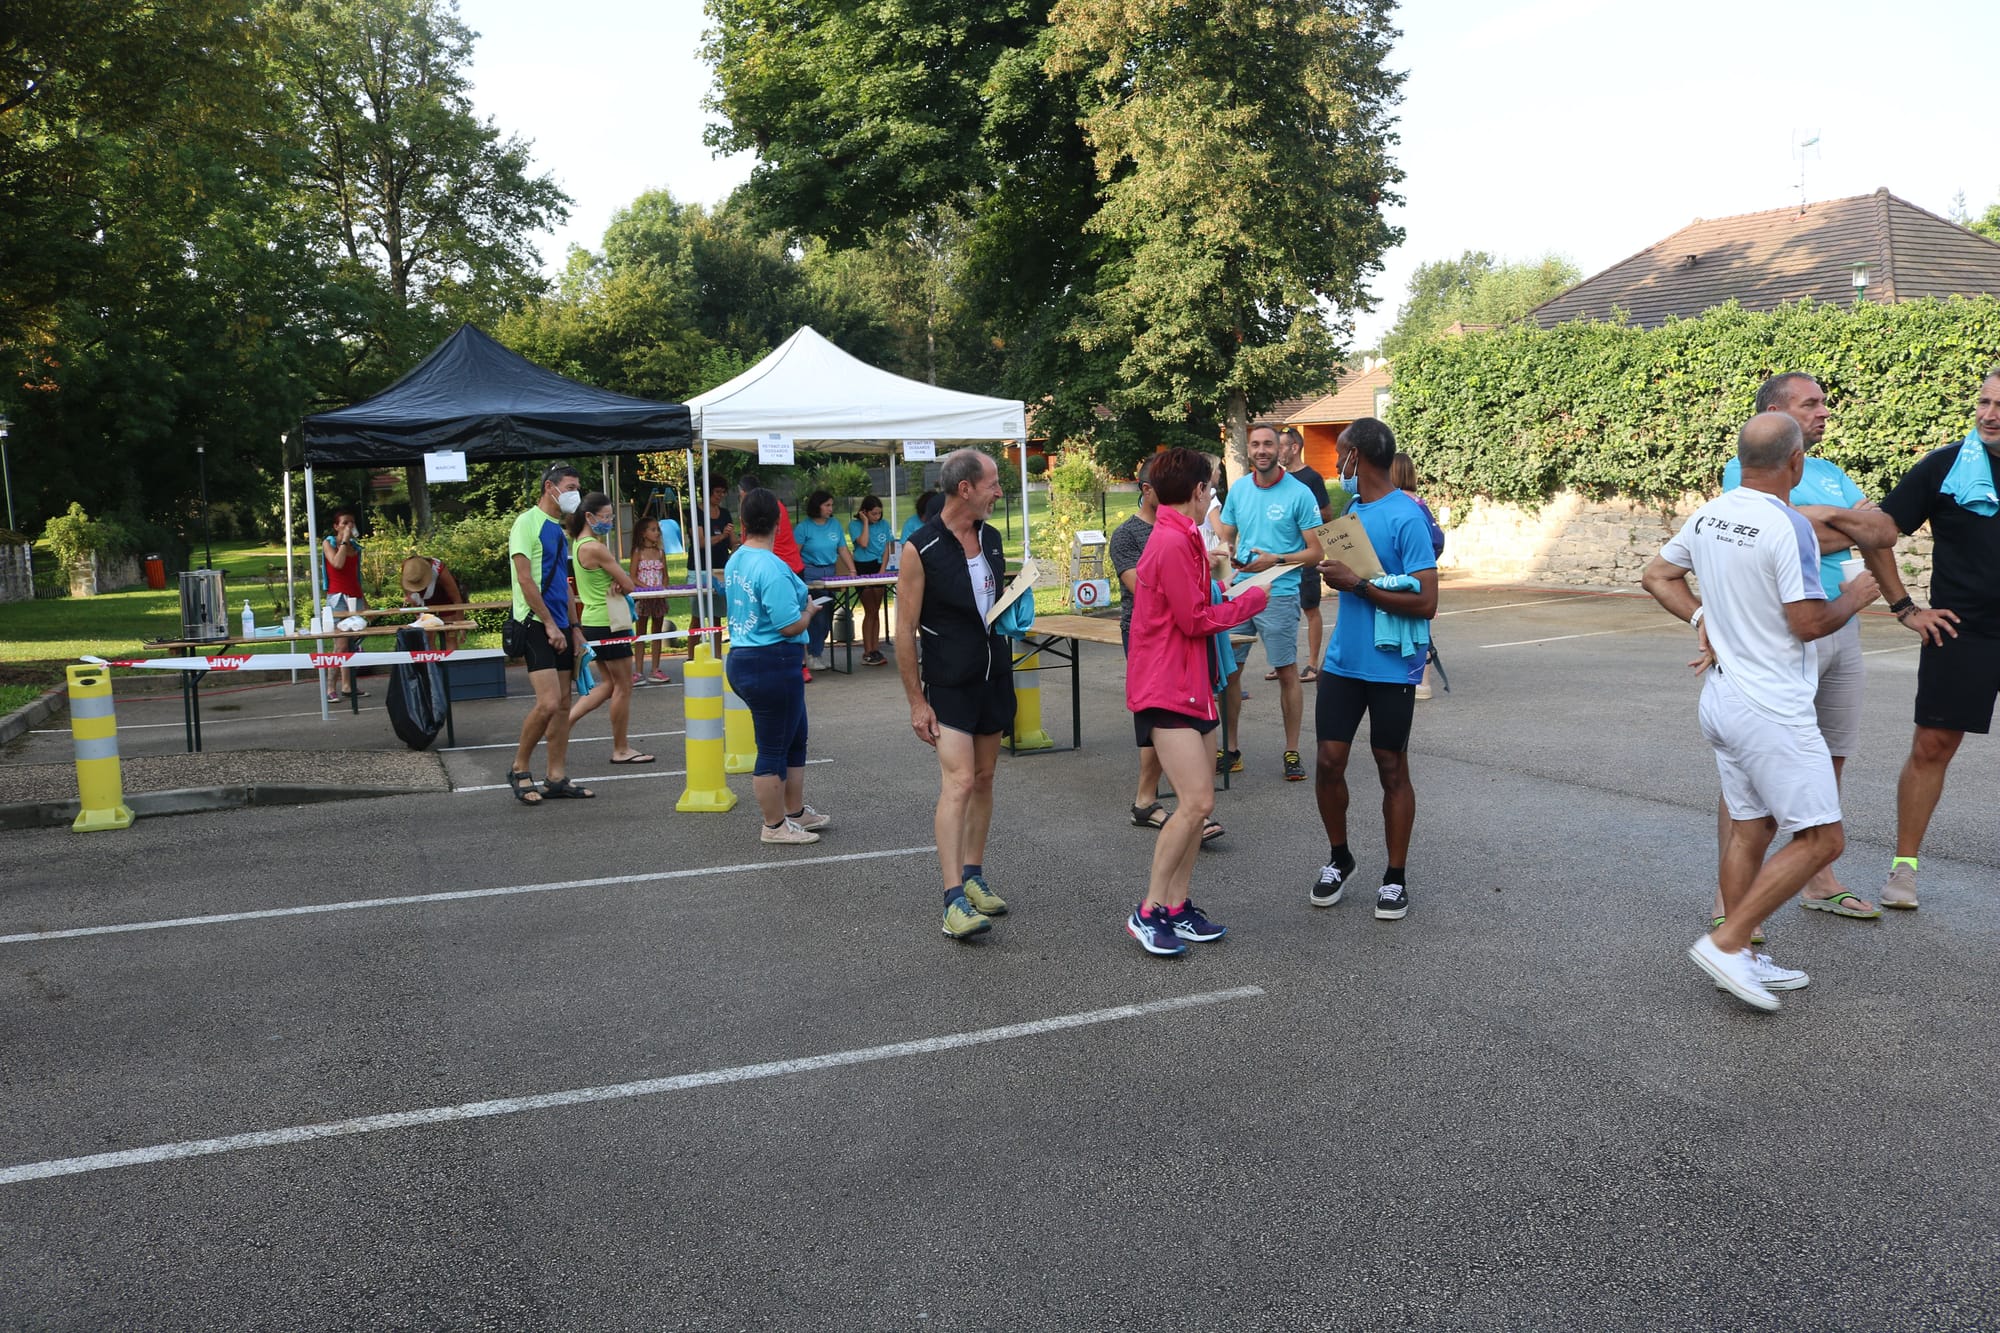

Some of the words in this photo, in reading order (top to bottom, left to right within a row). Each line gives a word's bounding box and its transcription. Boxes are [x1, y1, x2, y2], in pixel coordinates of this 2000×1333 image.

[209, 657, 243, 668] MAIF
[313, 654, 346, 666] MAIF
[412, 652, 446, 662] MAIF
